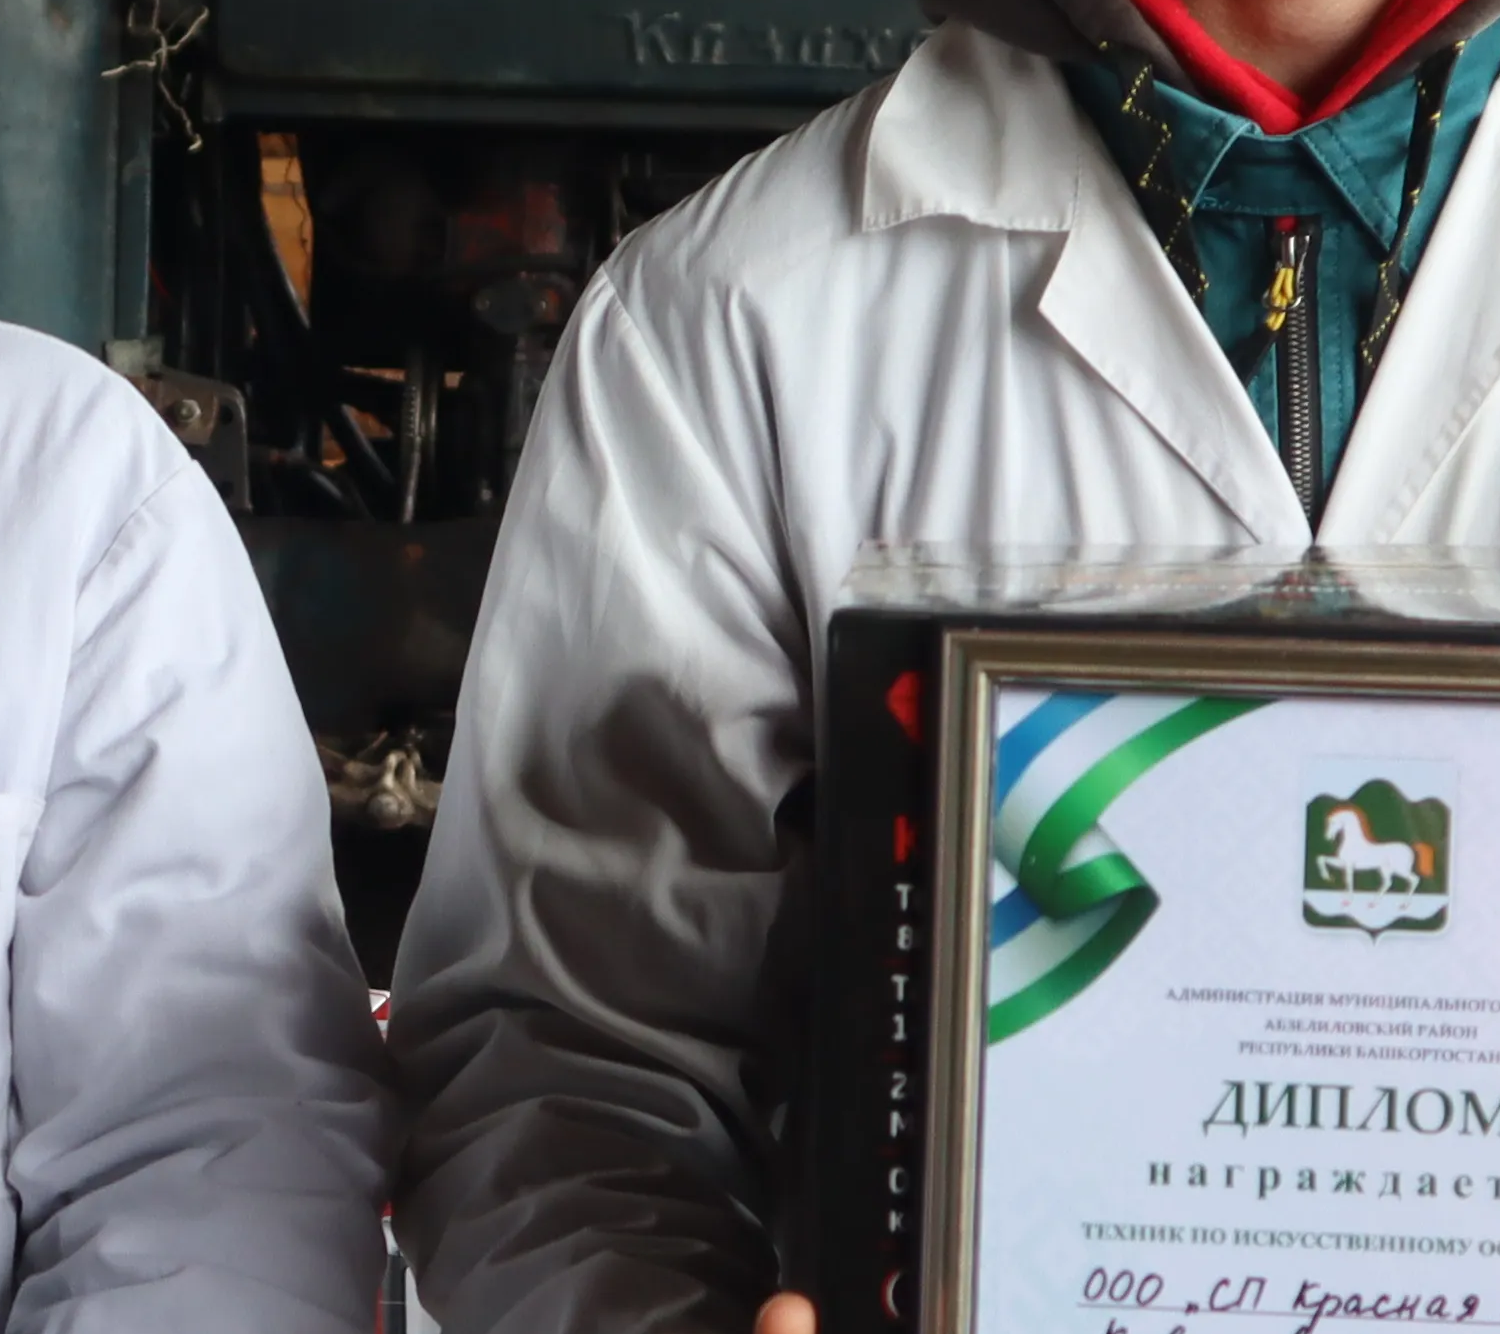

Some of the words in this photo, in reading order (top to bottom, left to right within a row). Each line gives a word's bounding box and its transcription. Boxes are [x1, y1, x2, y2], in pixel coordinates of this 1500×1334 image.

[1082, 1222, 1185, 1244] ТЕХНИК
[1191, 1226, 1227, 1245] ПО
[1233, 1228, 1472, 1256] ИСКУССТВЕННОМУ
[1082, 1267, 1165, 1309] ООО
[1292, 1278, 1480, 1334] Красная
